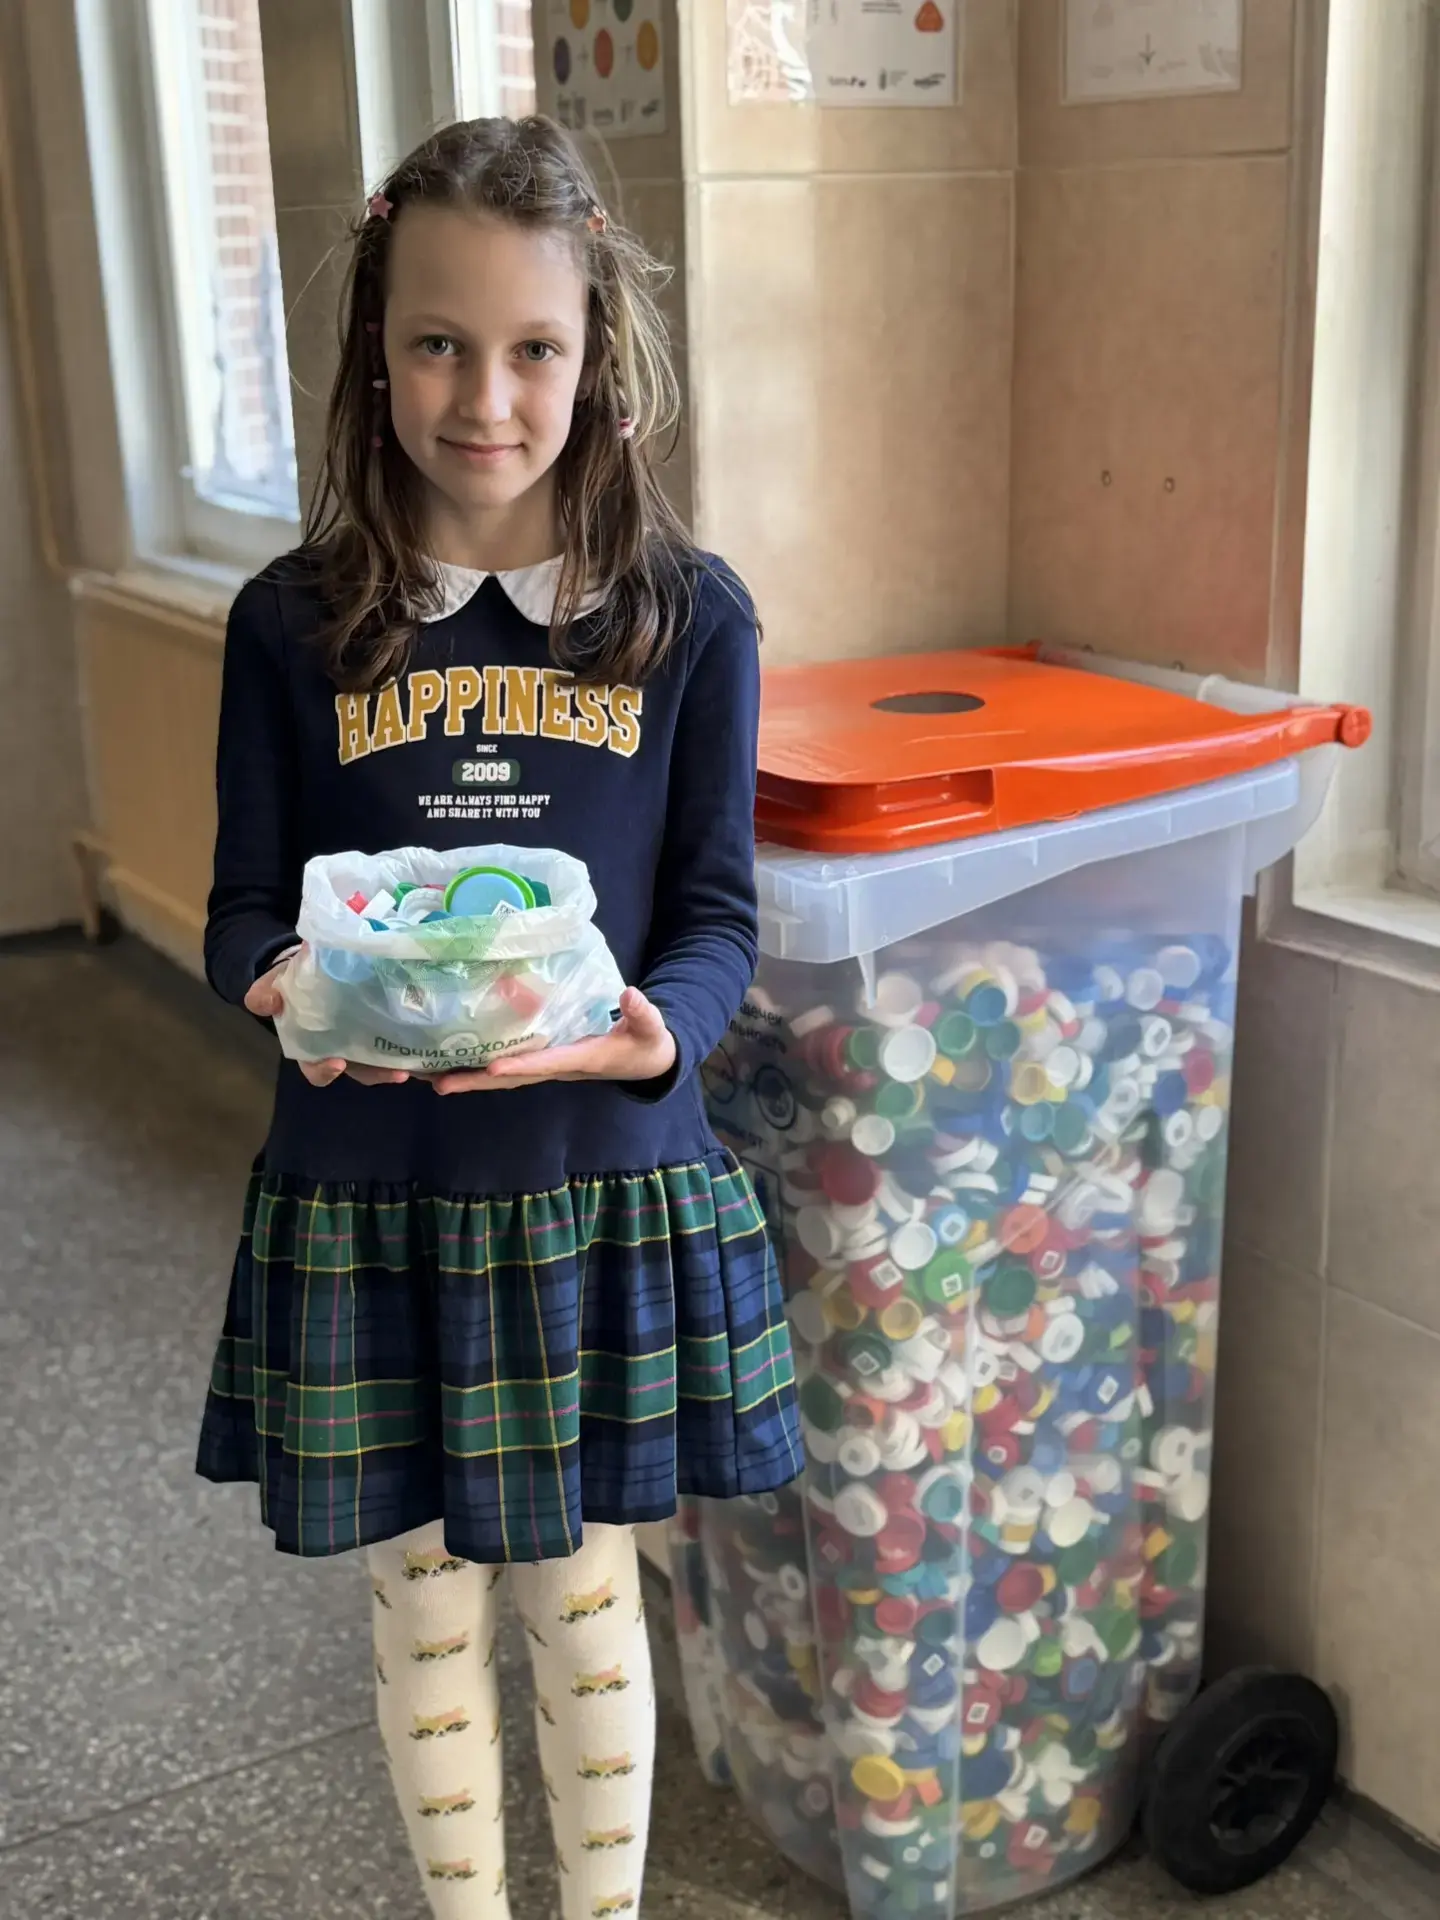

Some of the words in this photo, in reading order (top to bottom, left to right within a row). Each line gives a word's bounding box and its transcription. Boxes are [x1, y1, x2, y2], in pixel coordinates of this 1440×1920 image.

[335, 666, 643, 765] HAPPINESS
[476, 743, 498, 753] SINCE
[462, 762, 511, 782] 2009
[418, 795, 432, 806] WE
[433, 795, 453, 805] ARE
[455, 795, 492, 806] ALWAYS
[494, 795, 517, 805] FIND
[518, 795, 551, 805] HAPPY
[427, 807, 446, 818] AND
[448, 808, 481, 818] SHARE
[482, 808, 492, 818] IT
[495, 808, 519, 818] WITH
[521, 807, 541, 818] YOU
[374, 1036, 449, 1058] ПРОЧИЕ
[420, 1055, 489, 1069] WASTE
